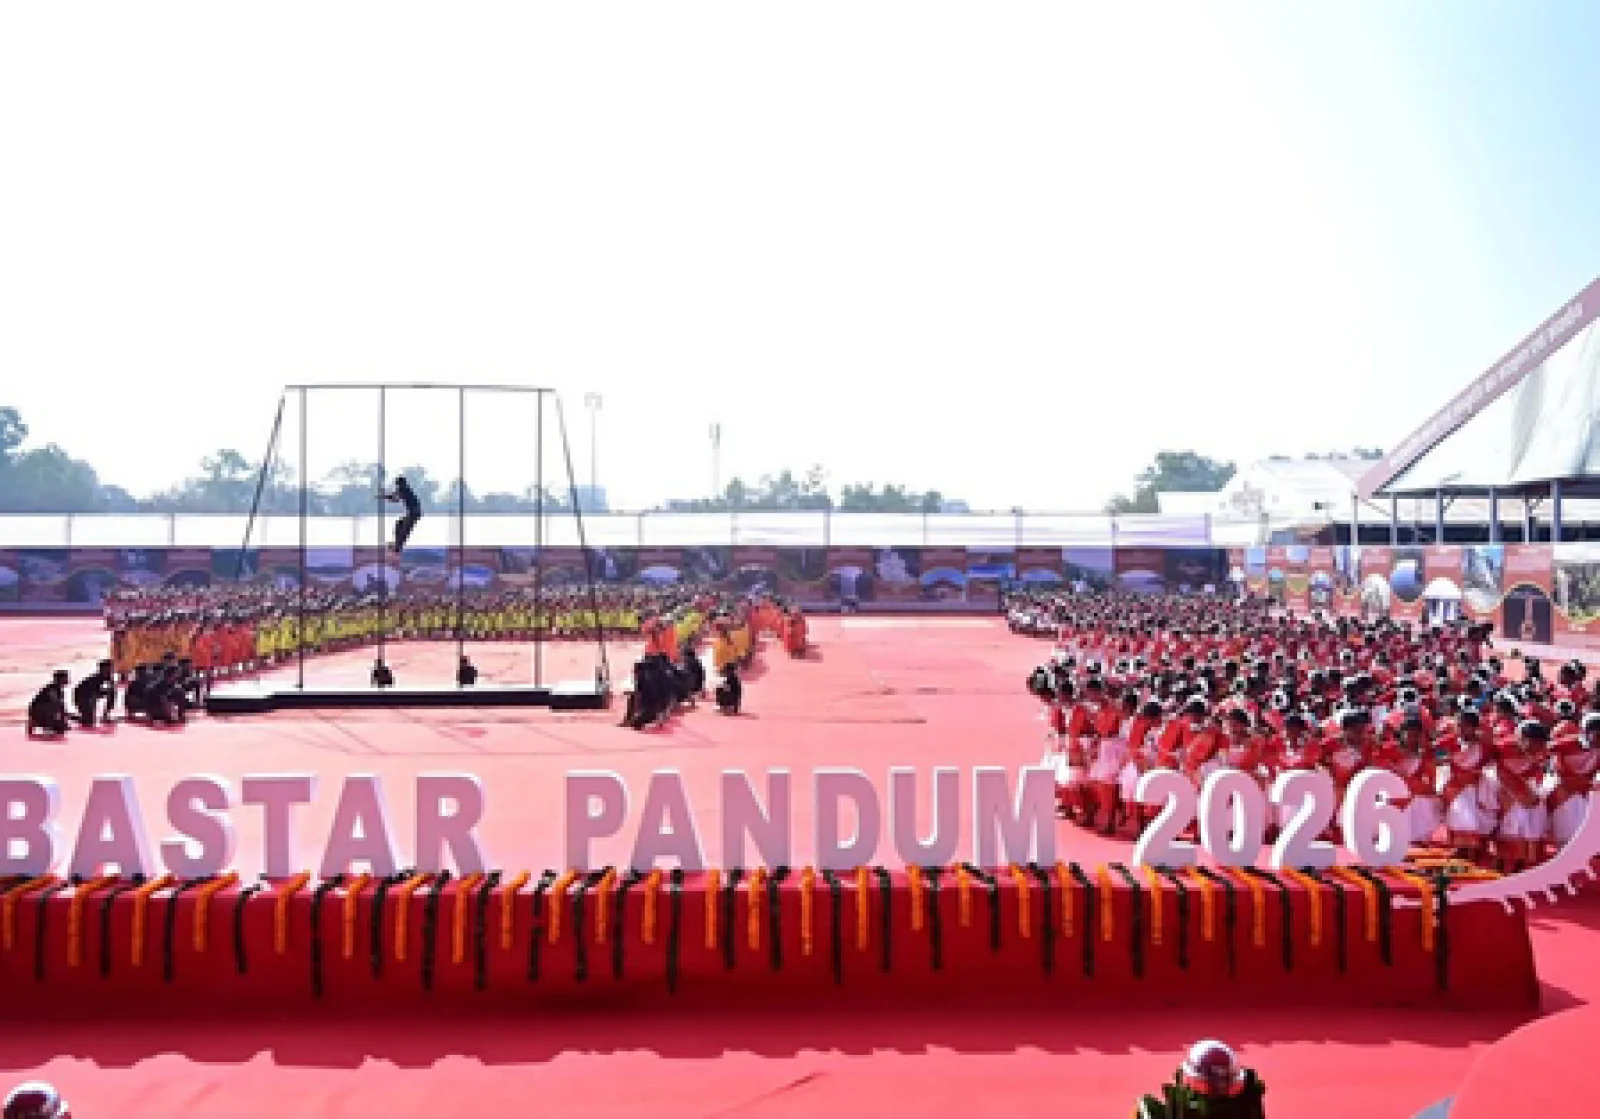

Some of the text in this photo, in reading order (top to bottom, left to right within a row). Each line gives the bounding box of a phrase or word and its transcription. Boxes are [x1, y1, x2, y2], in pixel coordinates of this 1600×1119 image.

[0, 767, 1410, 878] BASTAR PANDUM 2026
